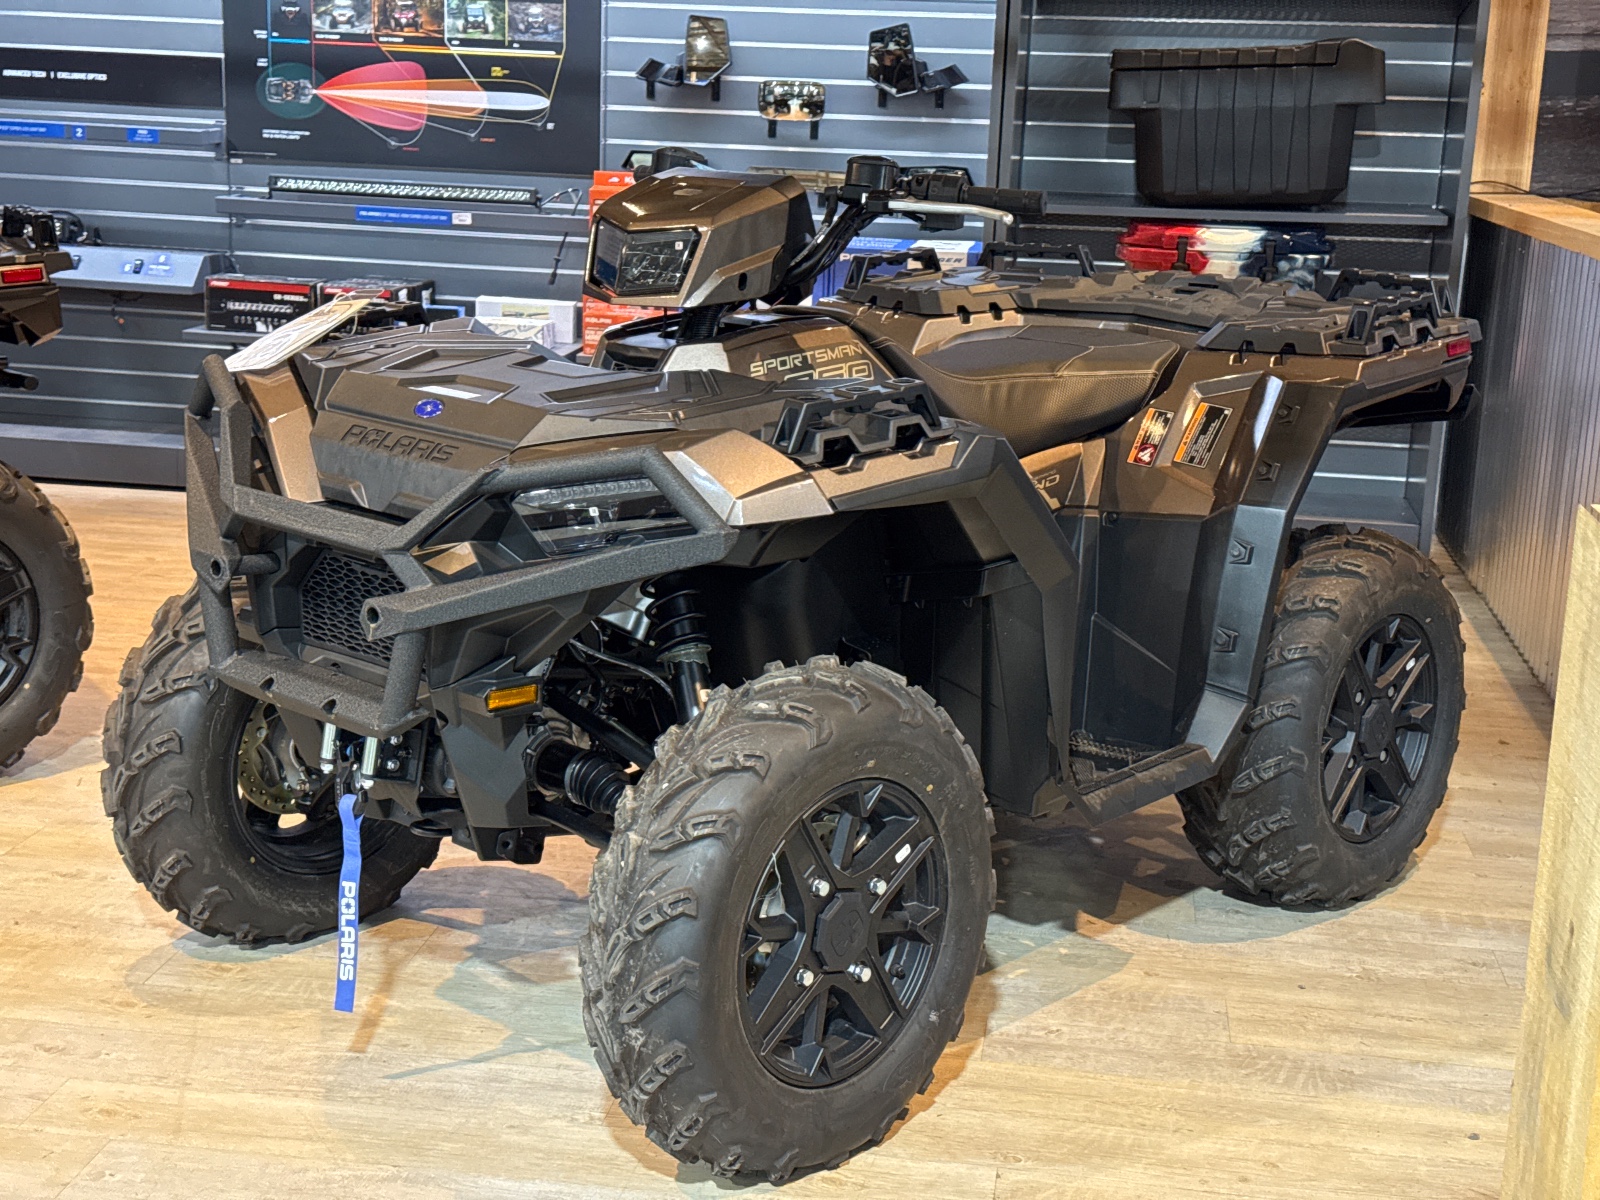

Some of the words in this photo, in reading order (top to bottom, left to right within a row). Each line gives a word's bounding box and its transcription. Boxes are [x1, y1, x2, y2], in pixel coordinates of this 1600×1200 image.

[75, 127, 83, 137] 2
[749, 344, 863, 377] SPORTSMAN
[340, 424, 460, 463] POLARIS
[339, 880, 357, 981] POLARIS
